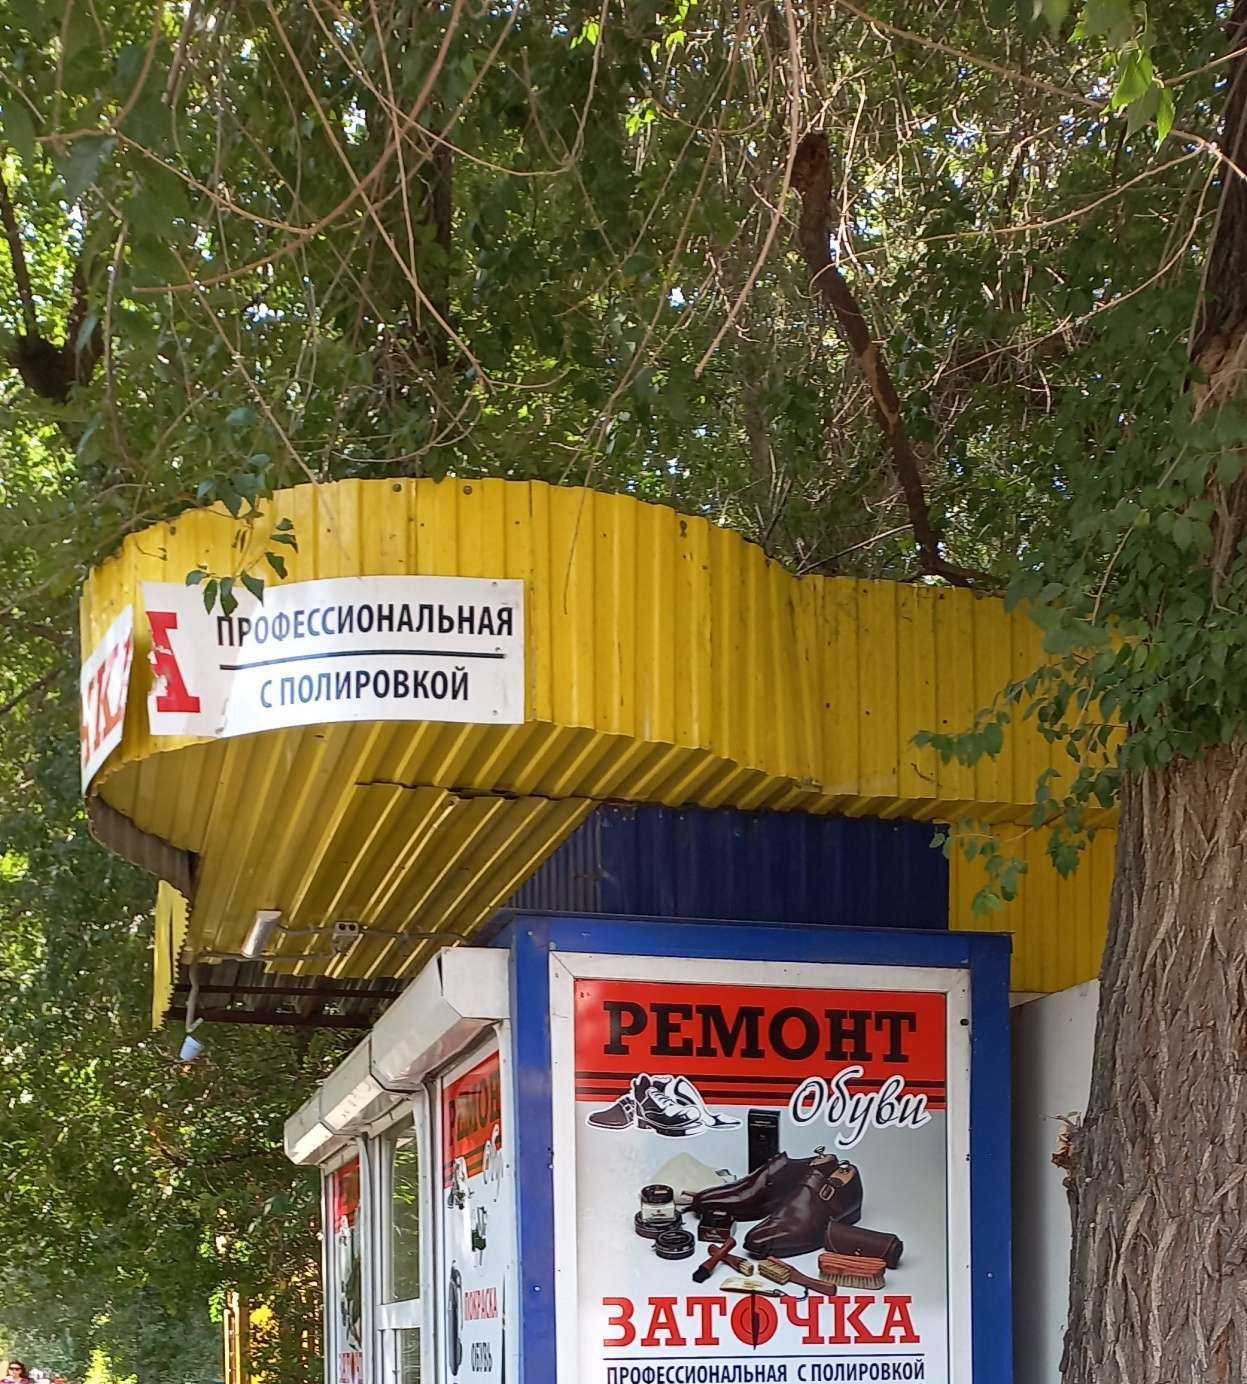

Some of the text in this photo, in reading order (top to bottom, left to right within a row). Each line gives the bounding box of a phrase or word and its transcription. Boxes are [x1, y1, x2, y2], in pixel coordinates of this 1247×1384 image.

[216, 603, 514, 647] ПРОФЕССИОНАЛЬНАЯ
[260, 666, 469, 709] С ПОЛИРОВКОЙ
[603, 1001, 916, 1063] РЕМОНТ
[793, 1067, 930, 1147] Обуви
[602, 1296, 920, 1348] ЗАТОЧКА
[798, 1364, 807, 1382] С
[811, 1359, 925, 1381] ПОЛИРОВКОЙ
